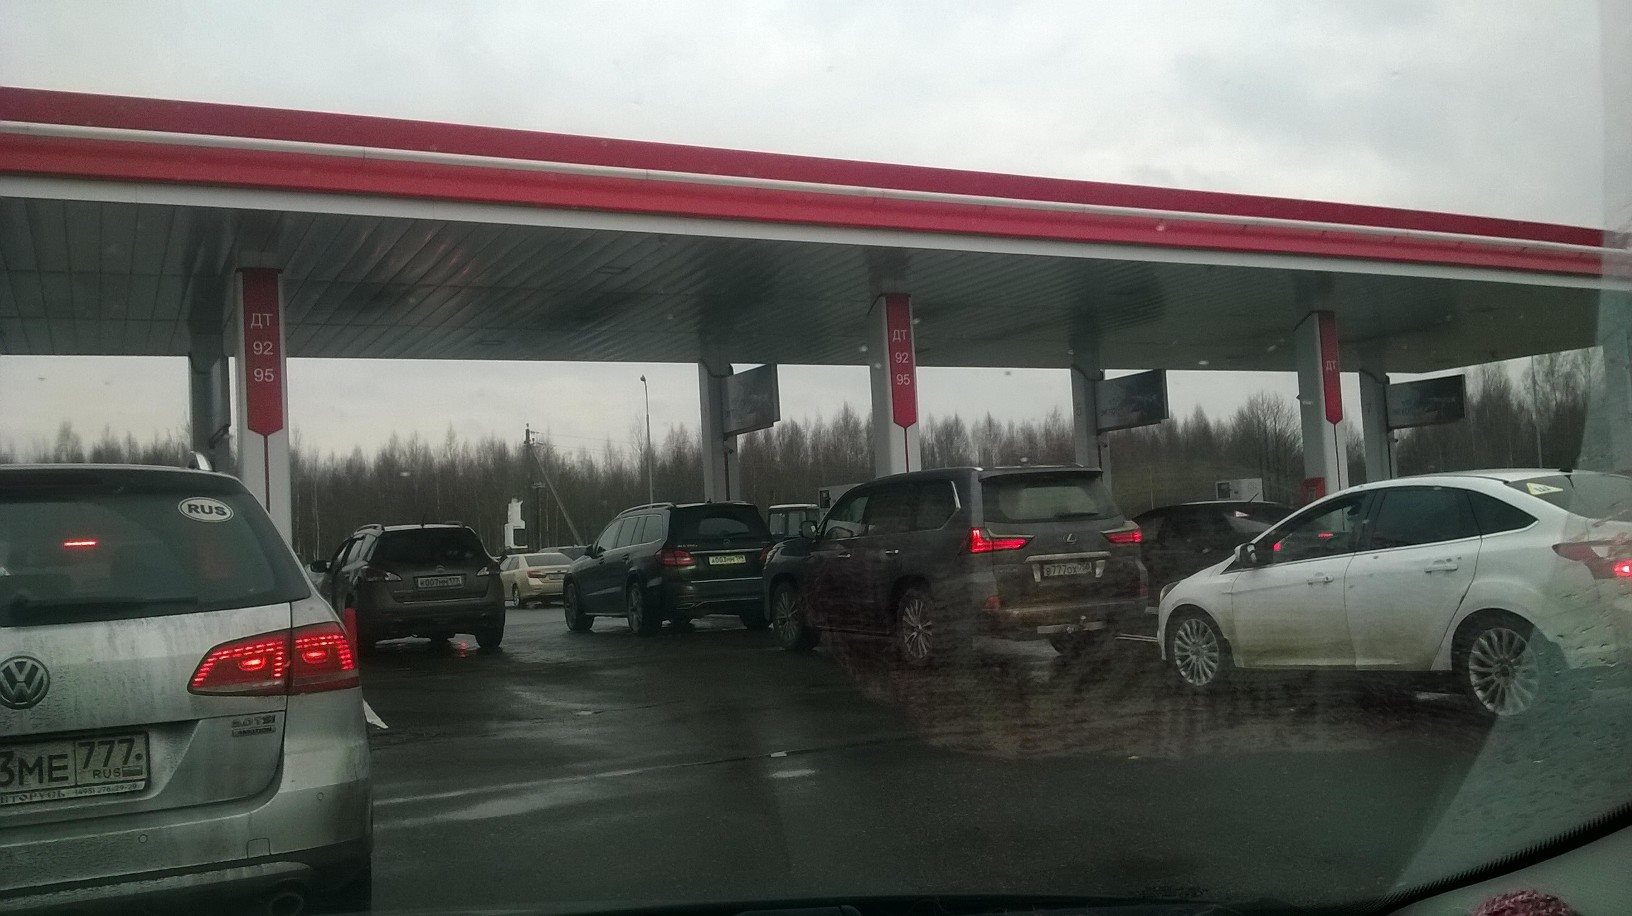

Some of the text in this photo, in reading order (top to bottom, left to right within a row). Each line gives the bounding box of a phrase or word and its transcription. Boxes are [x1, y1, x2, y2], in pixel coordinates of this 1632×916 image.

[250, 313, 274, 329] ДТ
[892, 329, 907, 343] ДТ
[253, 341, 274, 355] 92
[895, 351, 909, 364] 92
[253, 368, 275, 382] 95
[896, 373, 911, 386] 95
[187, 503, 227, 516] RUS
[78, 737, 135, 770] 777
[92, 767, 121, 779] RUS
